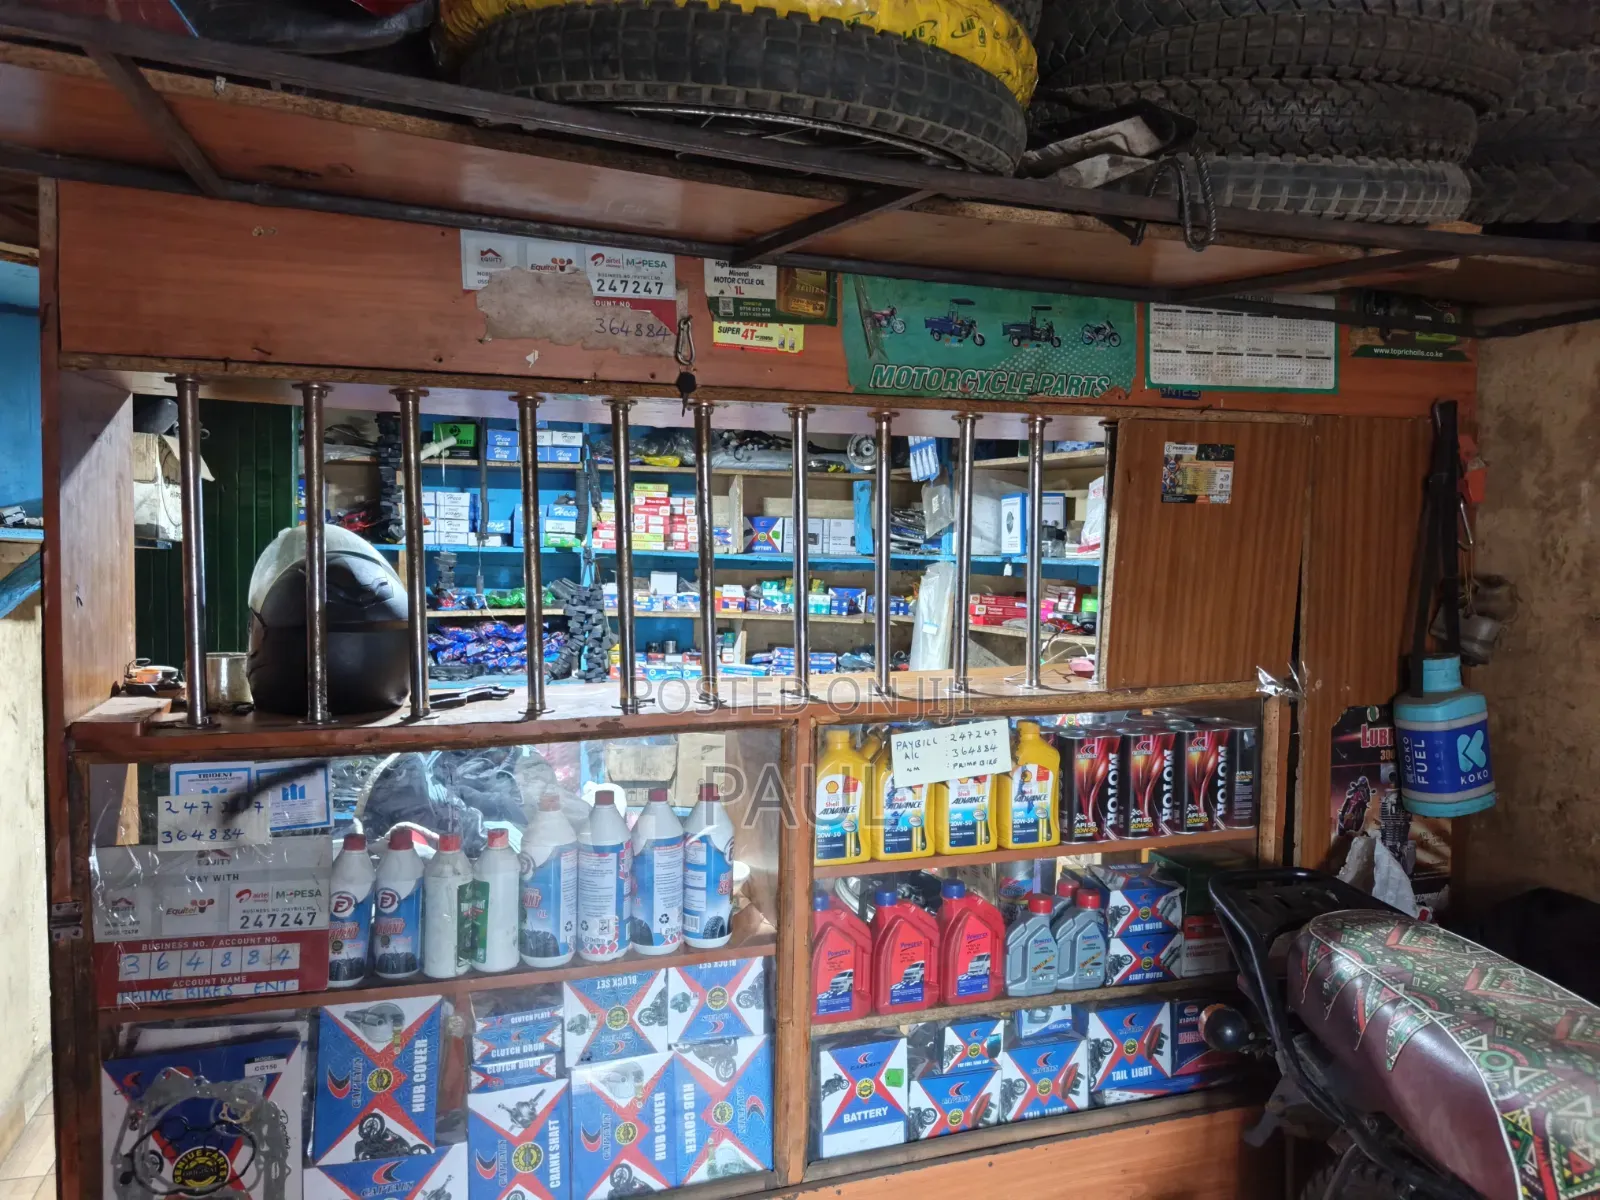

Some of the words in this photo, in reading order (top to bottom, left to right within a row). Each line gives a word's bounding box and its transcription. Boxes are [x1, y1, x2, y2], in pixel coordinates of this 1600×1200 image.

[714, 276, 735, 284] MOTOR
[737, 277, 754, 285] CYCLE
[728, 269, 749, 277] Mineral
[597, 279, 664, 295] 247247
[735, 286, 745, 295] 1L
[595, 317, 671, 338] 364884
[717, 326, 741, 335] SUPER
[741, 328, 757, 341] 4T
[868, 364, 1041, 394] MOTORCYCLE
[1036, 374, 1111, 398] PARTS
[1403, 737, 1412, 771] KOKO
[1414, 740, 1429, 784] FUEL
[1461, 769, 1489, 785] KOKO
[886, 800, 923, 810] ADVANCE
[952, 795, 987, 805] ADVANCE
[1014, 794, 1048, 802] ADVANCE
[819, 805, 857, 816] ADVANCE
[162, 829, 244, 844] 364884
[198, 858, 232, 867] EQUITY
[190, 874, 211, 883] PAY
[213, 873, 240, 882] WITH
[250, 891, 270, 899] airtel
[166, 906, 198, 916] Equitel
[240, 911, 317, 929] 247247
[1128, 924, 1144, 933] START
[1145, 921, 1163, 930] MOTOR
[142, 941, 189, 951] BUSINESS
[192, 940, 209, 948] NO.
[219, 937, 262, 946] ACCOUNT
[264, 936, 280, 944] NO.
[172, 978, 217, 987] ACCOUNT
[220, 975, 247, 984] NAME
[613, 975, 637, 988] BLOCK
[1128, 972, 1145, 981] START
[1146, 971, 1163, 979] MOTOR
[596, 980, 612, 990] SET
[510, 1013, 533, 1024] CLUTCH
[491, 1046, 520, 1058] CLUTCH
[523, 1042, 545, 1053] DRUM
[413, 1039, 428, 1079] COVER
[487, 1061, 517, 1074] CLUTCH
[519, 1058, 541, 1069] DRUM
[1111, 1070, 1128, 1081] TAIL
[1131, 1065, 1153, 1078] LIGHT
[352, 1057, 364, 1108] CAPTAIN
[412, 1082, 426, 1113] HUB
[683, 1083, 695, 1110] HUB
[654, 1092, 666, 1131] COVER
[843, 1106, 888, 1124] BATTERY
[549, 1119, 560, 1153] SHAFT
[603, 1113, 611, 1160] CAPTAIN
[684, 1112, 697, 1154] COVER
[654, 1134, 666, 1161] HUB
[499, 1140, 508, 1187] CAPTAIN
[549, 1157, 560, 1188] CRANK
[361, 1180, 415, 1198] CAPTAIN
